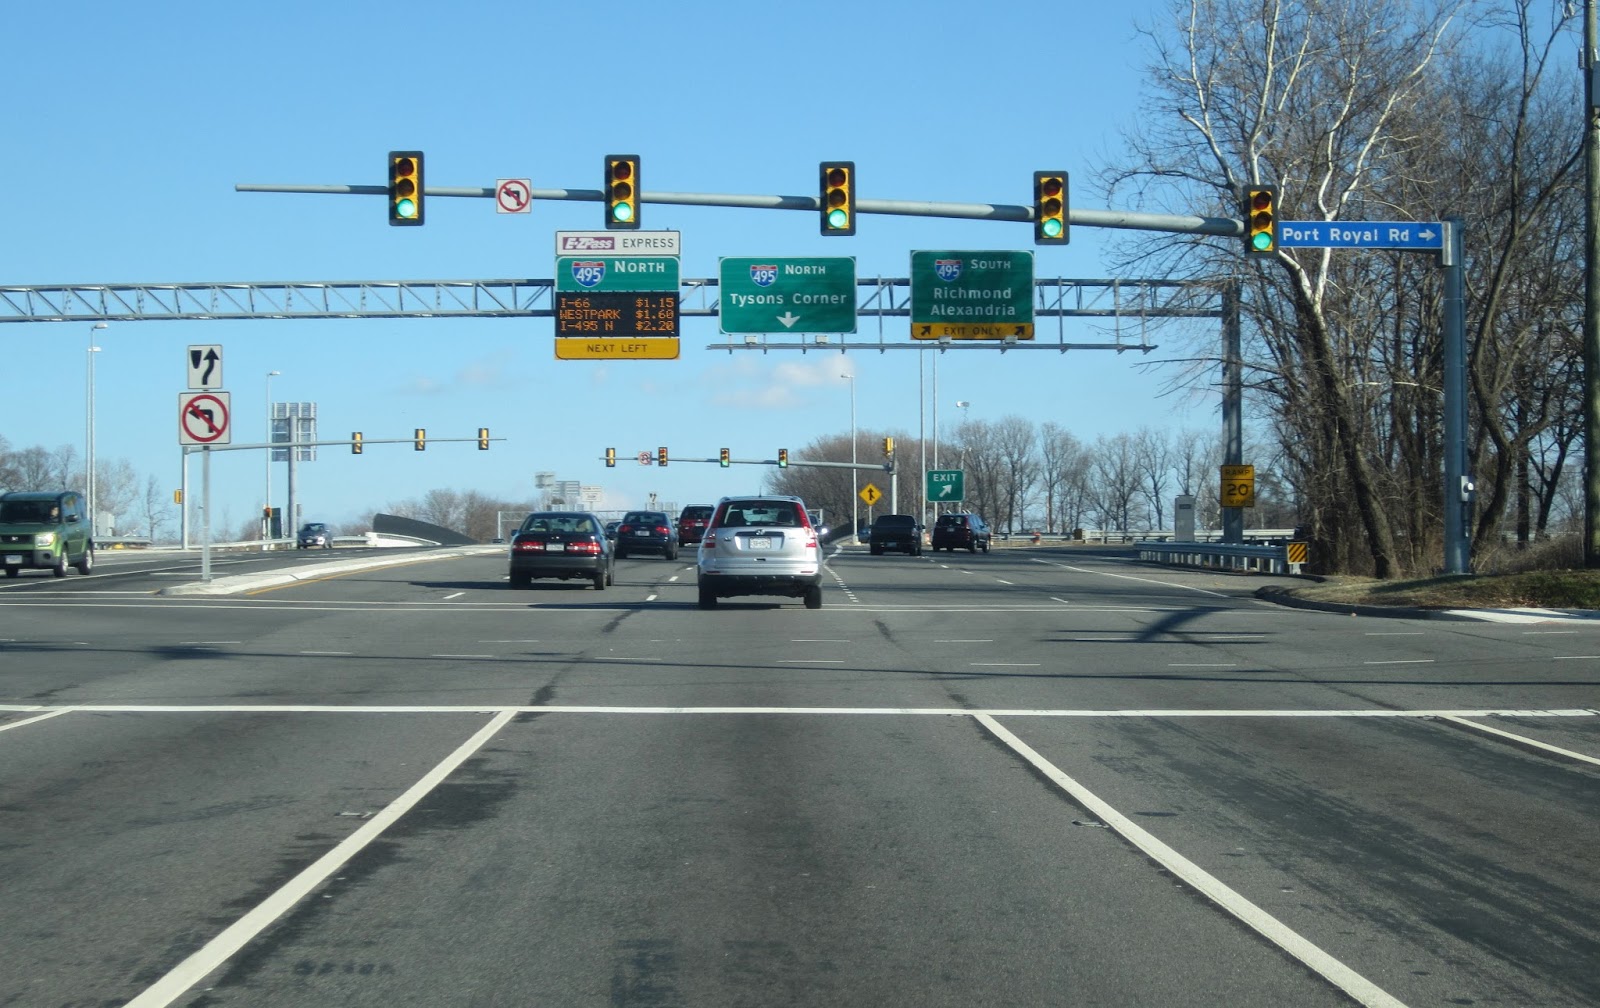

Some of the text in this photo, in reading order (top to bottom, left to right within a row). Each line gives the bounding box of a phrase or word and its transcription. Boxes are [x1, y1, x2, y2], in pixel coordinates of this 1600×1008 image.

[1283, 228, 1409, 244] Port Royal Rd
[623, 239, 674, 248] EXPRESS
[576, 261, 665, 282] 495 NORTH
[753, 270, 775, 282] 495
[785, 264, 826, 274] NORTH
[938, 265, 960, 277] 495
[970, 259, 1011, 269] SOUTH
[934, 287, 1012, 299] Richmond
[561, 298, 591, 308] I-66
[635, 298, 674, 308] $1.15
[730, 293, 847, 307] Tysons Corner
[560, 309, 621, 319] WESTPARK
[635, 309, 674, 319] $1.60
[930, 304, 1016, 316] Alexandria
[561, 321, 614, 331] I-495 N
[635, 321, 674, 331] $2.20
[943, 327, 1001, 336] EXIT ONLY
[587, 344, 648, 353] NEXT LEFT
[933, 473, 957, 482] EXIT
[1227, 483, 1248, 496] 20
